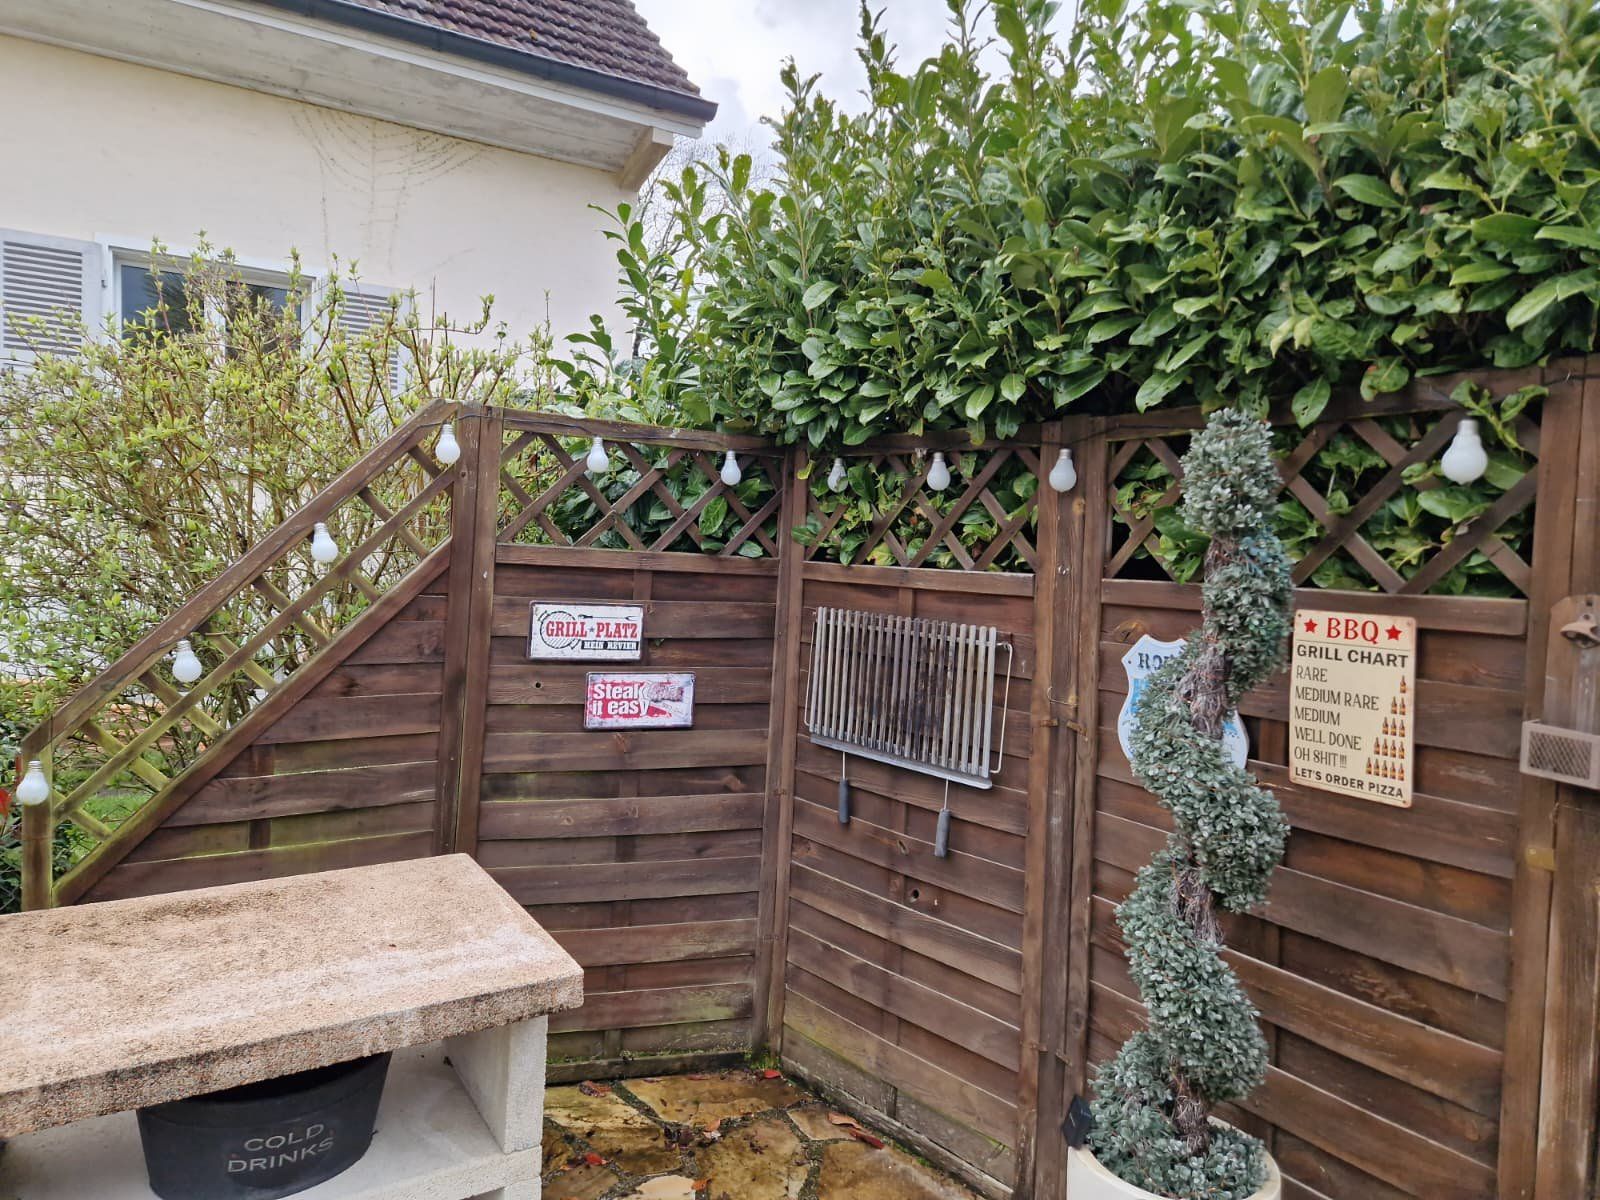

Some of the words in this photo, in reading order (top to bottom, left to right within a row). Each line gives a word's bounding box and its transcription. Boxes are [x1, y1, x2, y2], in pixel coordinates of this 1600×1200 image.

[546, 621, 587, 638] GRILL
[596, 622, 637, 638] PLATZ
[1326, 617, 1379, 644] BBQ
[583, 642, 605, 650] MEIN
[607, 642, 636, 650] REVIER
[1297, 644, 1342, 661] GRILL
[1347, 650, 1408, 668] CHART
[1296, 665, 1328, 682] RARE
[592, 701, 602, 716] it
[607, 701, 649, 720] easy
[1295, 686, 1340, 705] MEDIUM
[1344, 692, 1379, 711] RARE
[1294, 706, 1340, 726] MEDIUM
[1294, 726, 1326, 745] WELL
[1329, 732, 1362, 750] DONE
[1294, 746, 1310, 761] OH
[1295, 767, 1322, 780] LET'S
[1326, 773, 1364, 790] ORDER
[1368, 782, 1404, 798] PIZZA
[244, 1124, 324, 1151] COLD
[228, 1137, 334, 1172] DRINKS
